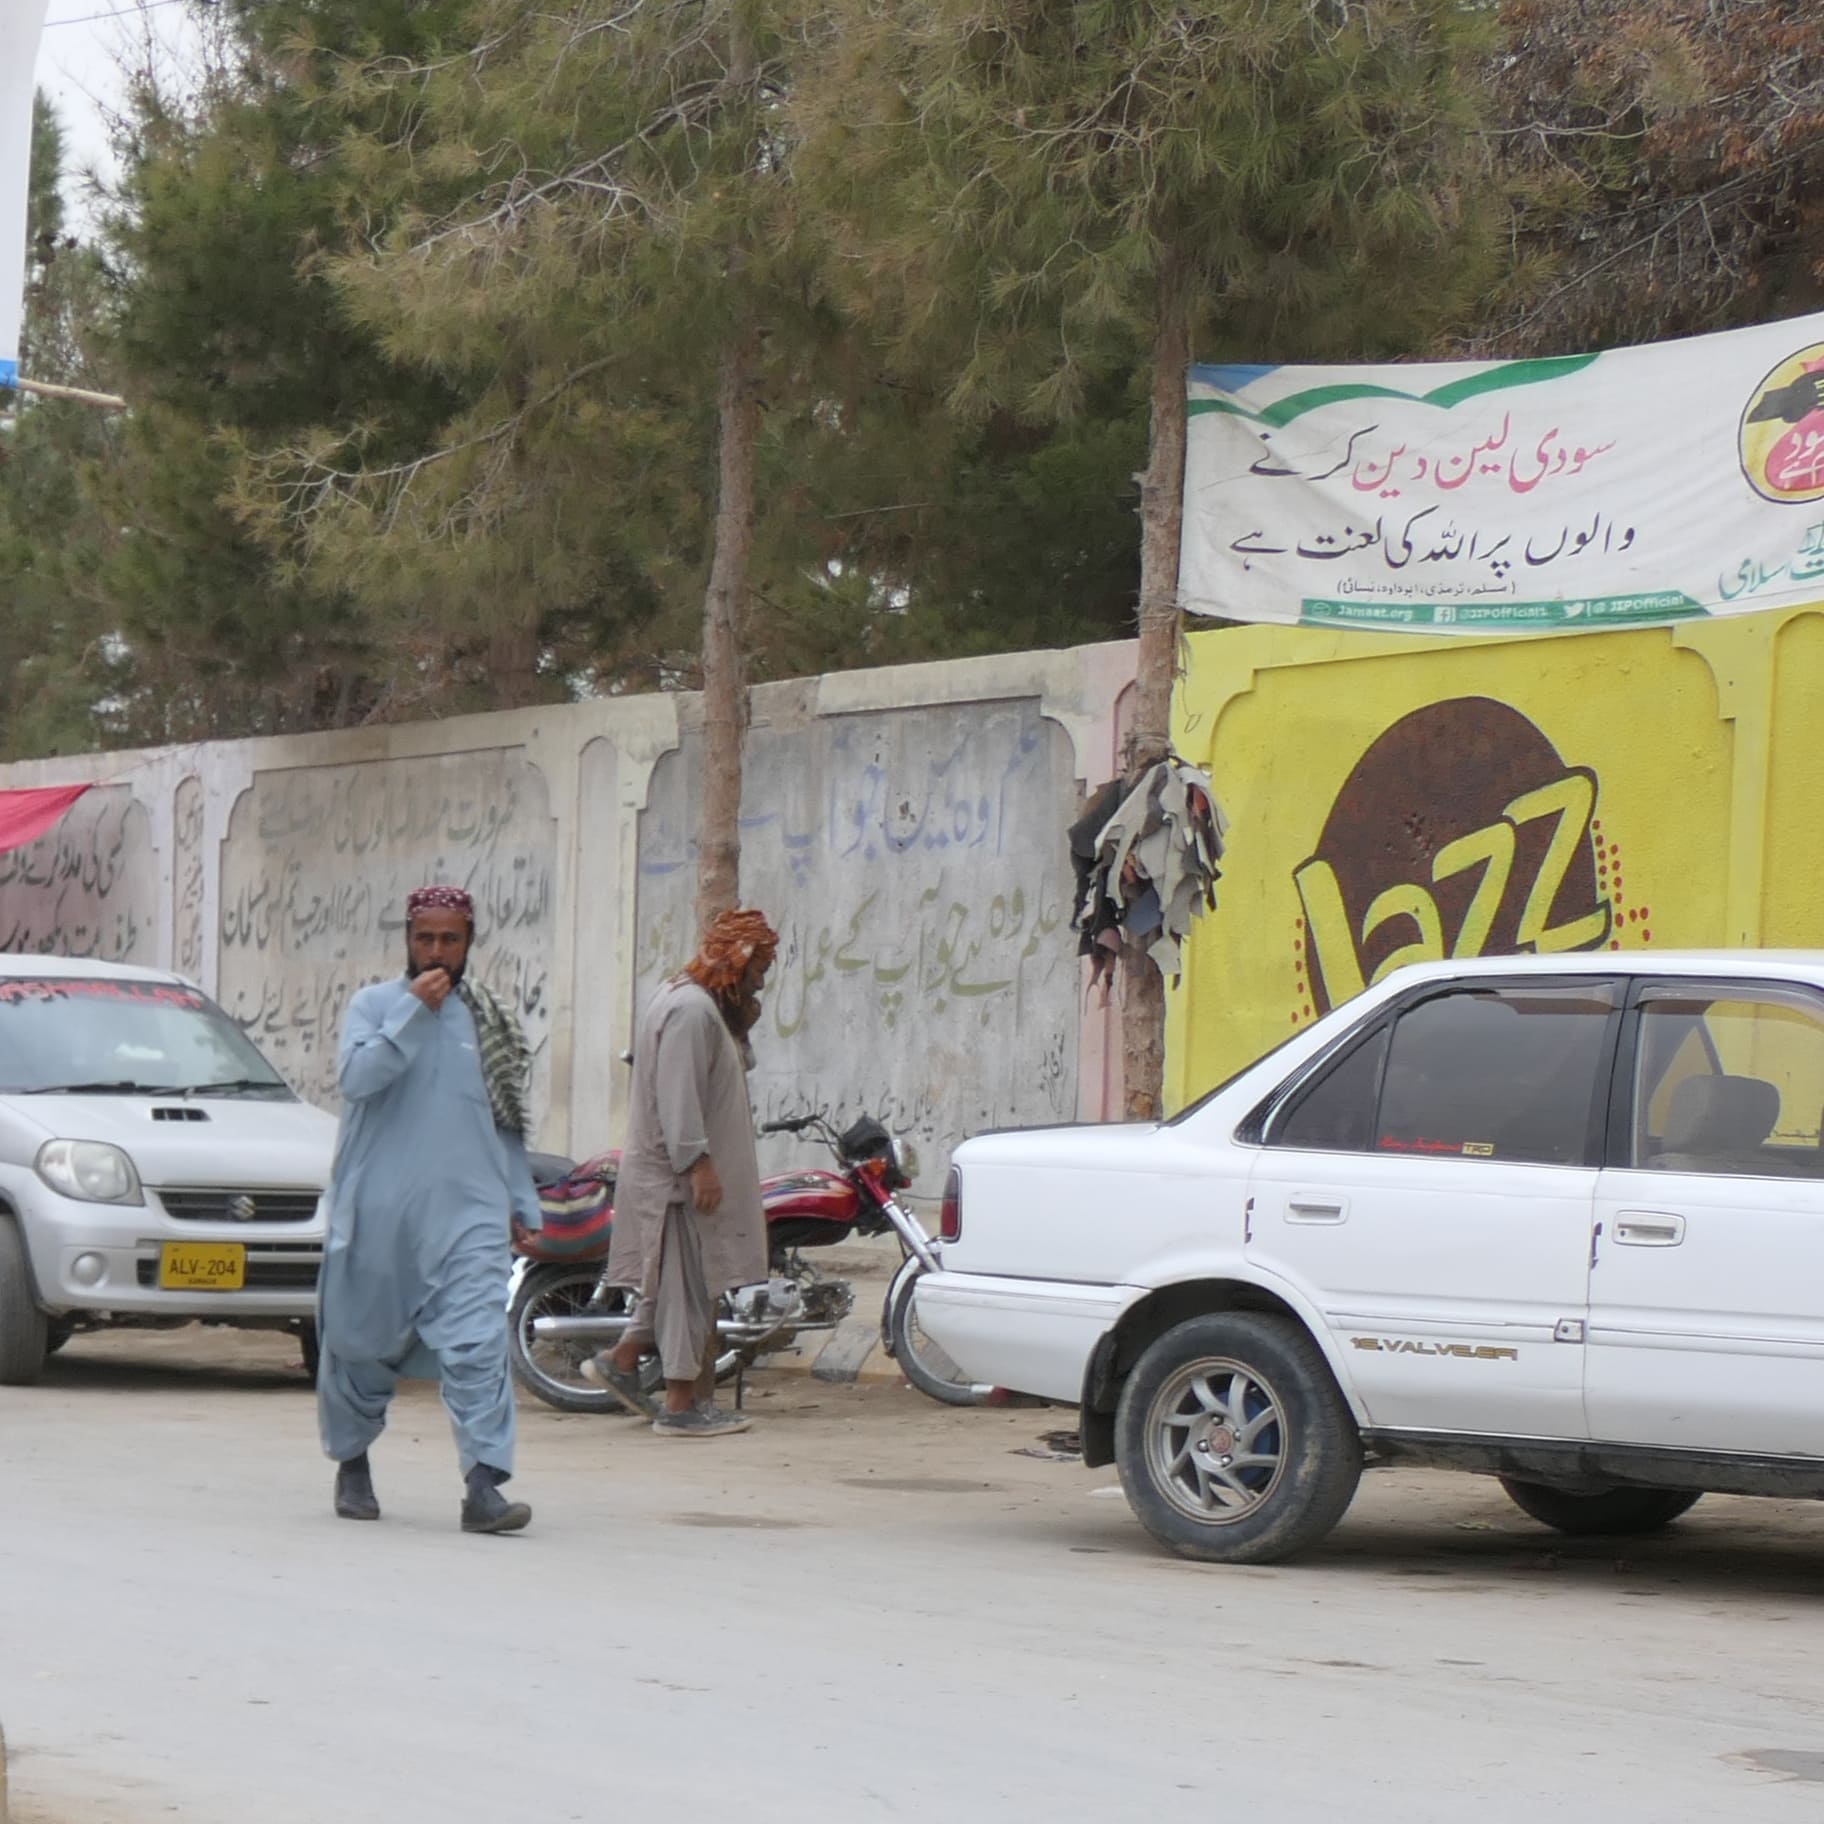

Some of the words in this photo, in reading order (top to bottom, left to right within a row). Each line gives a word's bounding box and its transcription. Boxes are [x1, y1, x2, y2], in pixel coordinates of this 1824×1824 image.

[1351, 442, 1428, 499] دین
[1434, 410, 1510, 491] لین
[1507, 427, 1616, 494] سودی
[1228, 528, 1288, 571] ہے
[1295, 515, 1384, 560] لعنت
[1384, 504, 1440, 569] کی
[1418, 519, 1478, 563] اللہ
[1477, 533, 1513, 579] پر
[1524, 511, 1637, 567] والوں
[169, 1258, 237, 1276] ALV-204
